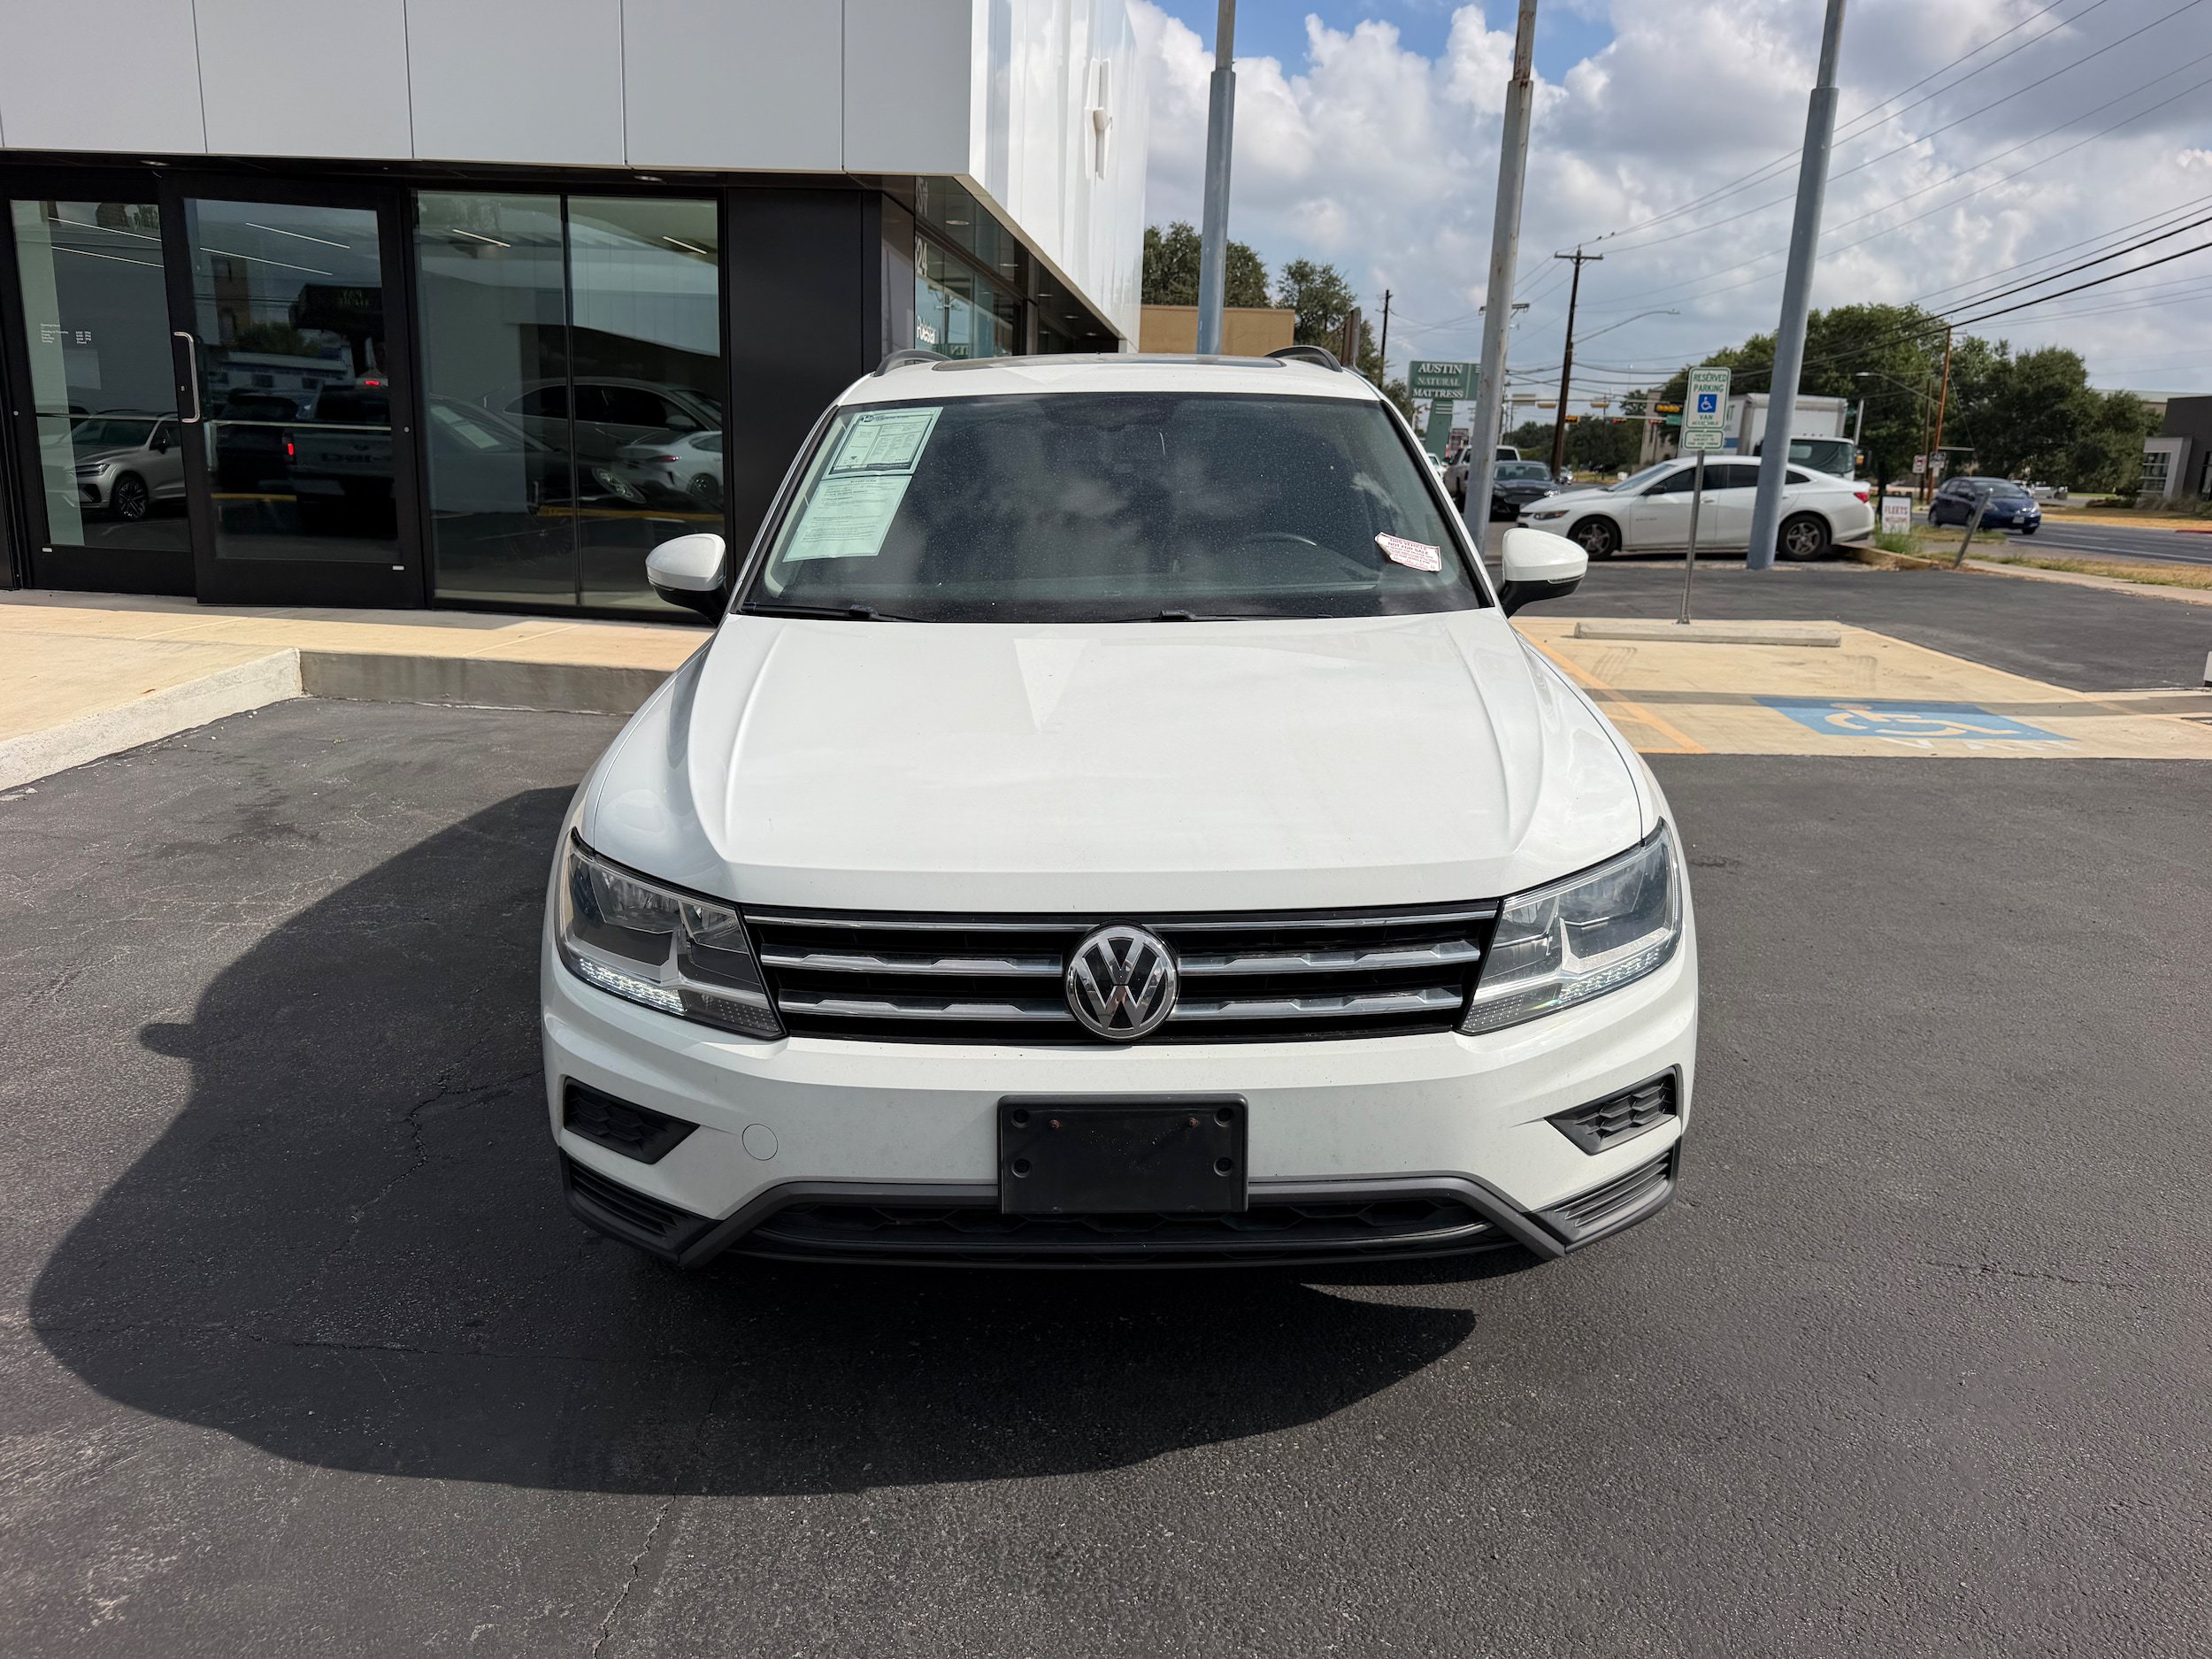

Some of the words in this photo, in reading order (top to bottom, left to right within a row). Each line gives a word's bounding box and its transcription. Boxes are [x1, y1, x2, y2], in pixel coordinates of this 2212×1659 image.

[1417, 363, 1463, 374] AUSTIN
[1417, 377, 1460, 387] NATURAL
[1693, 373, 1728, 382] RESERVED
[1412, 388, 1464, 398] MATTRESS
[1403, 541, 1427, 551] VEHICLE
